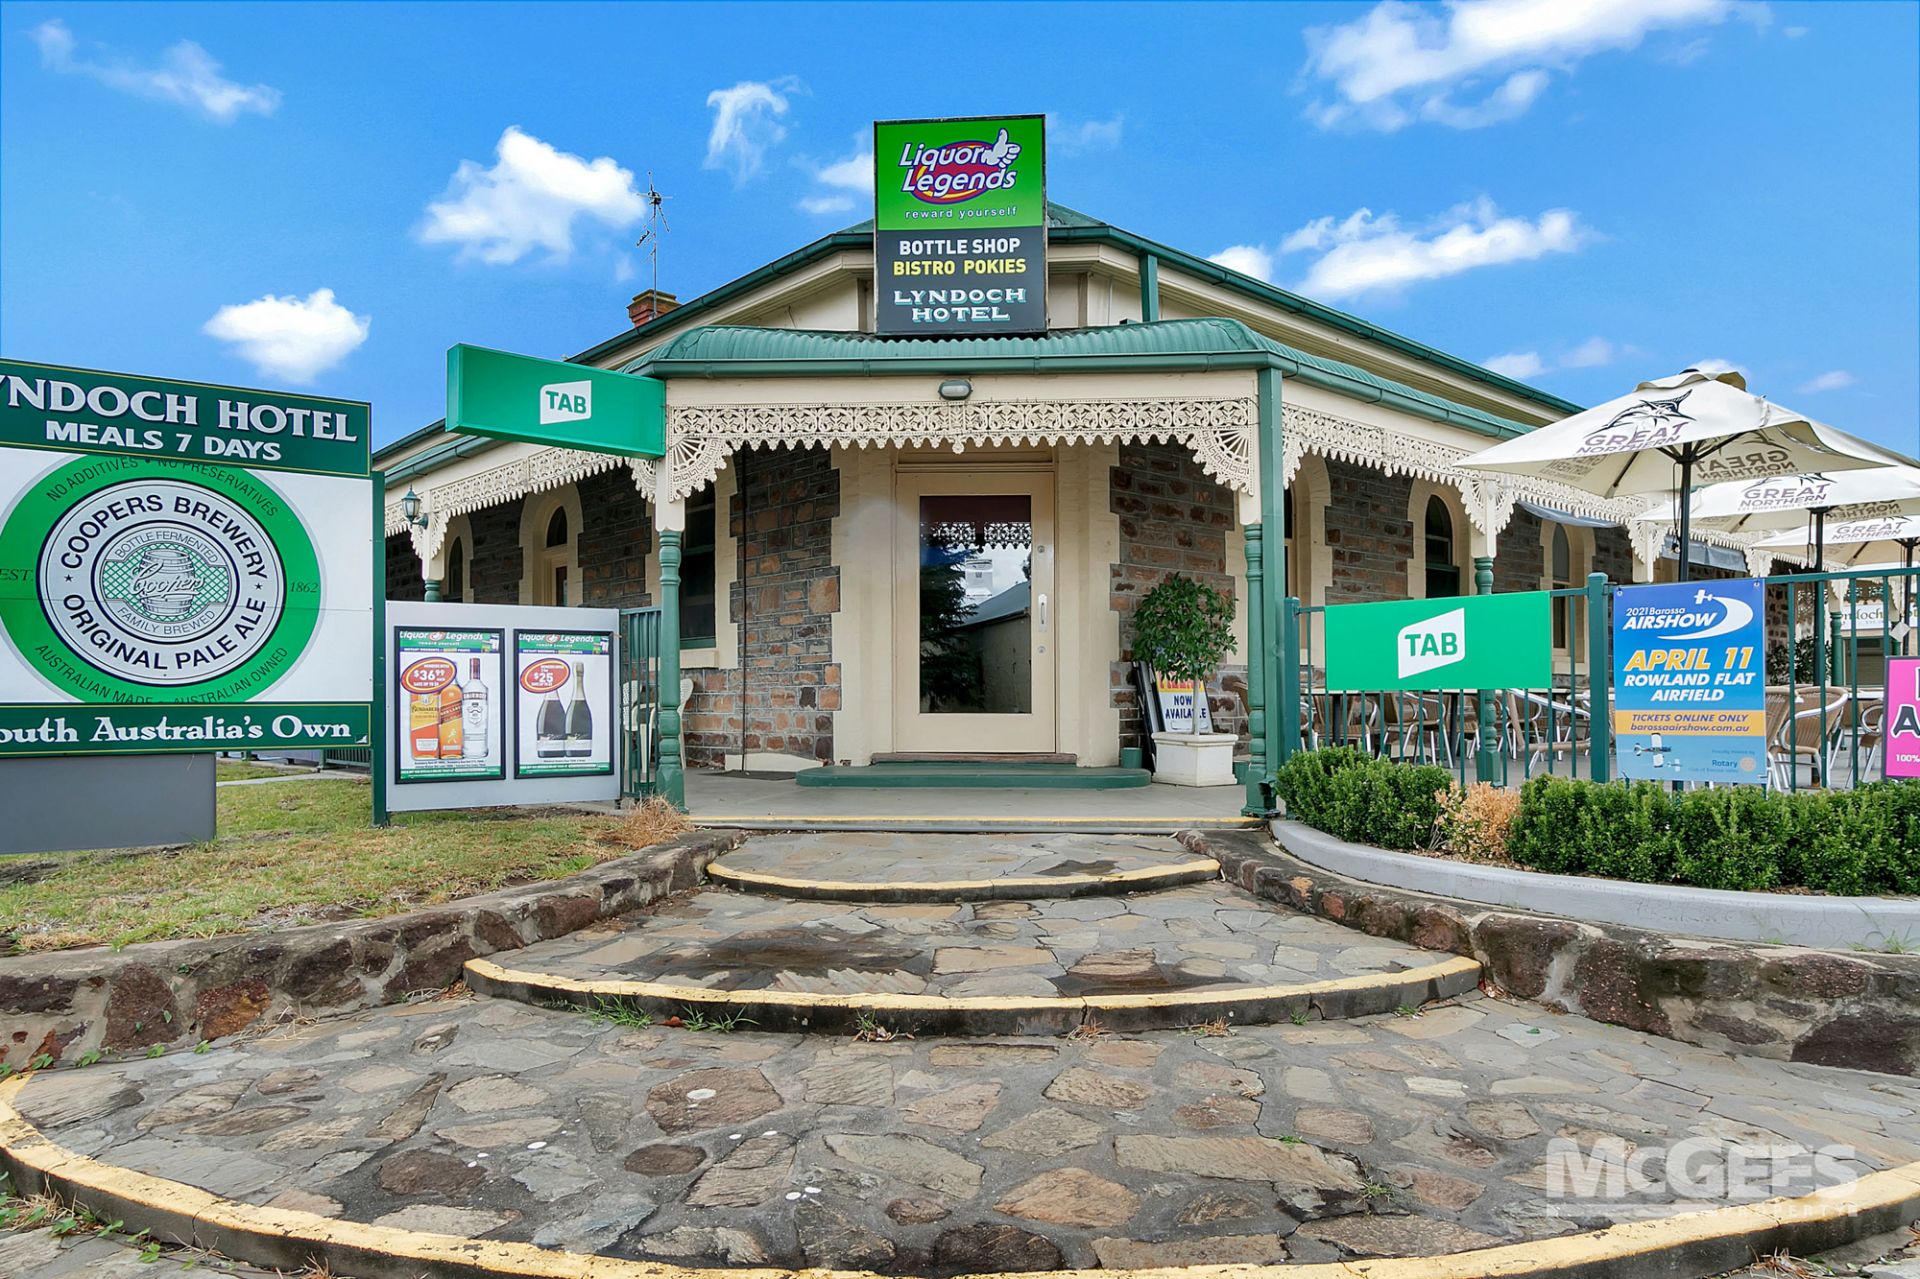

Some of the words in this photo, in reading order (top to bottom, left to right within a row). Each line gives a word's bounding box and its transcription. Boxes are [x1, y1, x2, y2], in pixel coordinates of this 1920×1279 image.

[899, 143, 985, 171] Liquor
[902, 167, 1017, 198] Legends
[905, 209, 953, 219] reward
[959, 206, 1018, 220] yourself
[899, 239, 968, 256] BOTTLE
[972, 237, 1021, 254] SHOP
[893, 260, 956, 276] BISTRO
[964, 258, 1027, 275] POKIES
[894, 287, 1027, 306] LYNDOCH
[911, 306, 1011, 323] HOTEL
[545, 390, 587, 414] TAB
[218, 399, 358, 442] HOTEL
[46, 420, 164, 450] MEALS
[176, 433, 193, 453] 7
[204, 435, 282, 461] DAYS
[1584, 421, 1690, 447] GREAT
[1576, 434, 1681, 454] NORTHERN
[46, 484, 68, 502] NO
[67, 456, 139, 488] ADDITIVES
[182, 460, 279, 517] PRESERVATIVES
[1739, 493, 1828, 508] NORTHERN
[1744, 483, 1831, 500] GREAT
[61, 494, 163, 569] COOPERS
[173, 495, 268, 580] BREWERY
[1837, 521, 1908, 534] GREAT
[114, 532, 155, 559] BOTTLE
[155, 530, 219, 563] FERMENTED
[0, 569, 35, 582] EST.
[290, 581, 320, 593] 1862
[117, 607, 160, 633] FAMILY
[163, 610, 216, 635] BREWED
[1622, 612, 1719, 630] AIRSHOW
[63, 594, 168, 670] ORIGINAL
[175, 634, 238, 670] PALE
[234, 597, 266, 640] ALE
[445, 631, 484, 642] Legends
[559, 634, 595, 644] Legends
[1405, 633, 1458, 656] TAB
[250, 646, 289, 682] OWNED
[1623, 648, 1712, 671] APRIL
[1719, 647, 1754, 670] 11
[34, 644, 111, 699] AUSTRALIAN
[1623, 672, 1711, 687] ROWLAND
[1713, 671, 1757, 686] FLAT
[1174, 696, 1192, 706] NOW
[1650, 688, 1726, 702] AIRFIELD
[1631, 713, 1671, 722] TICKETS
[1673, 713, 1716, 722] ONLINE
[1717, 713, 1750, 722] ONLY
[89, 715, 264, 742] Australia's
[271, 714, 352, 739] Own
[1630, 722, 1750, 733] barossaairshow.com.au
[1712, 759, 1738, 768] Rotary
